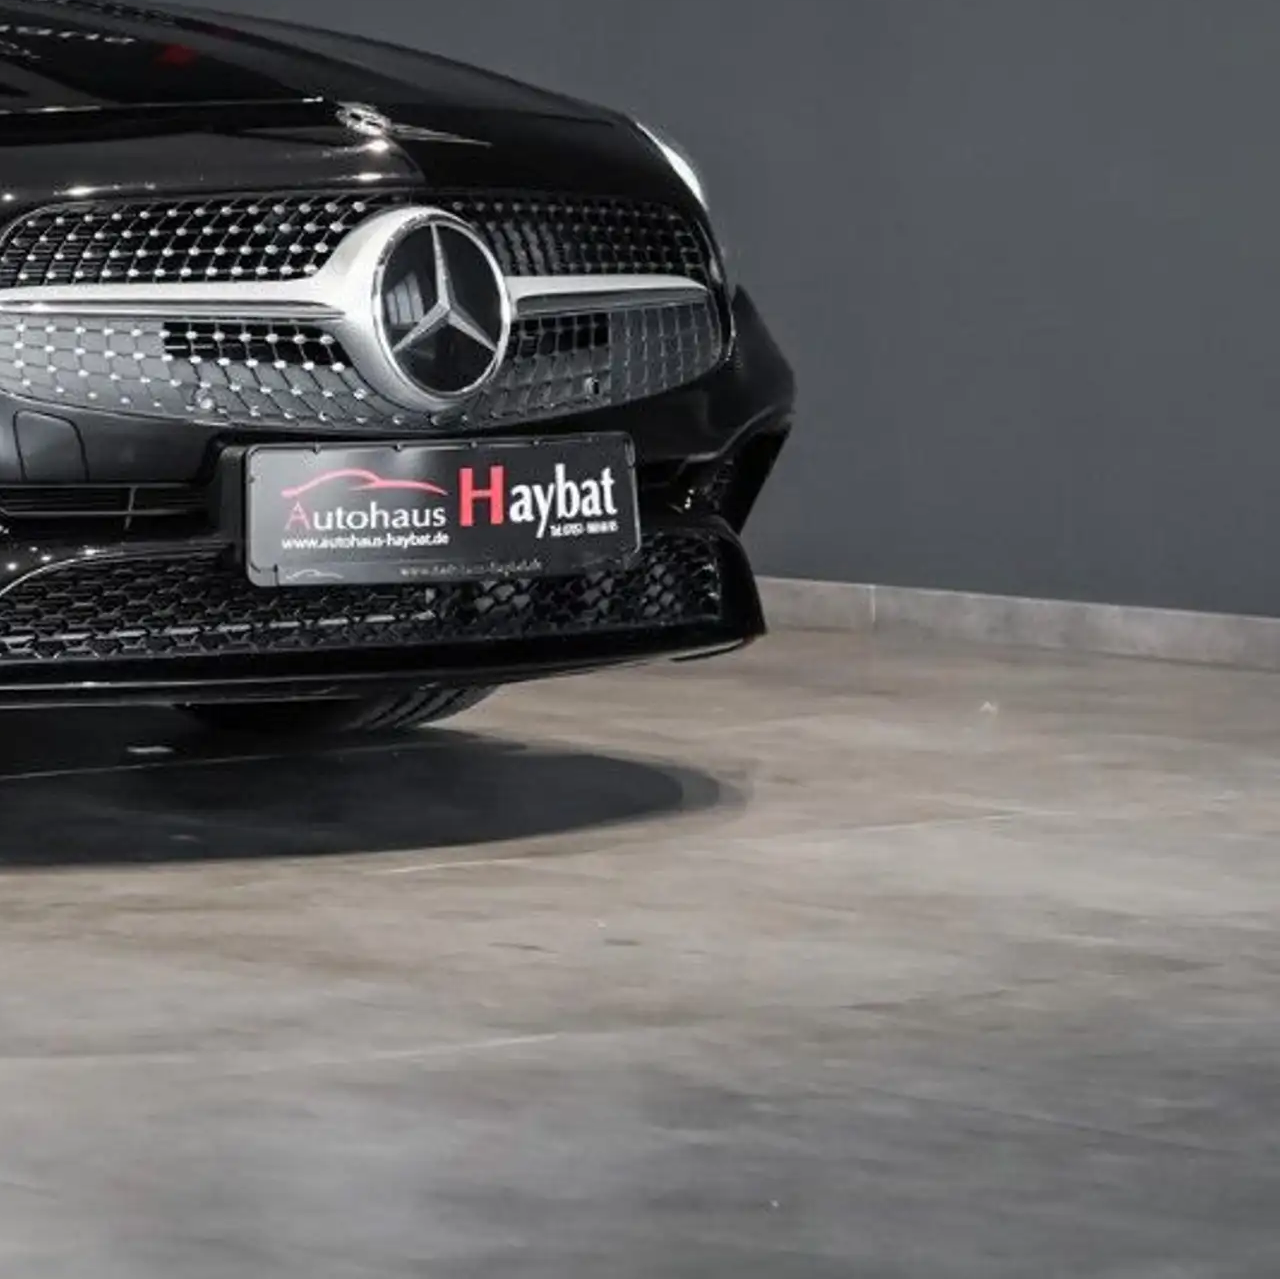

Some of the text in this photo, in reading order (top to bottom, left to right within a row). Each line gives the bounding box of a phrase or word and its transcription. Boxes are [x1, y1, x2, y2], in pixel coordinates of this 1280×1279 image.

[284, 463, 618, 539] Autohaus Haybat
[281, 532, 450, 550] www.autohaus-haybat.de
